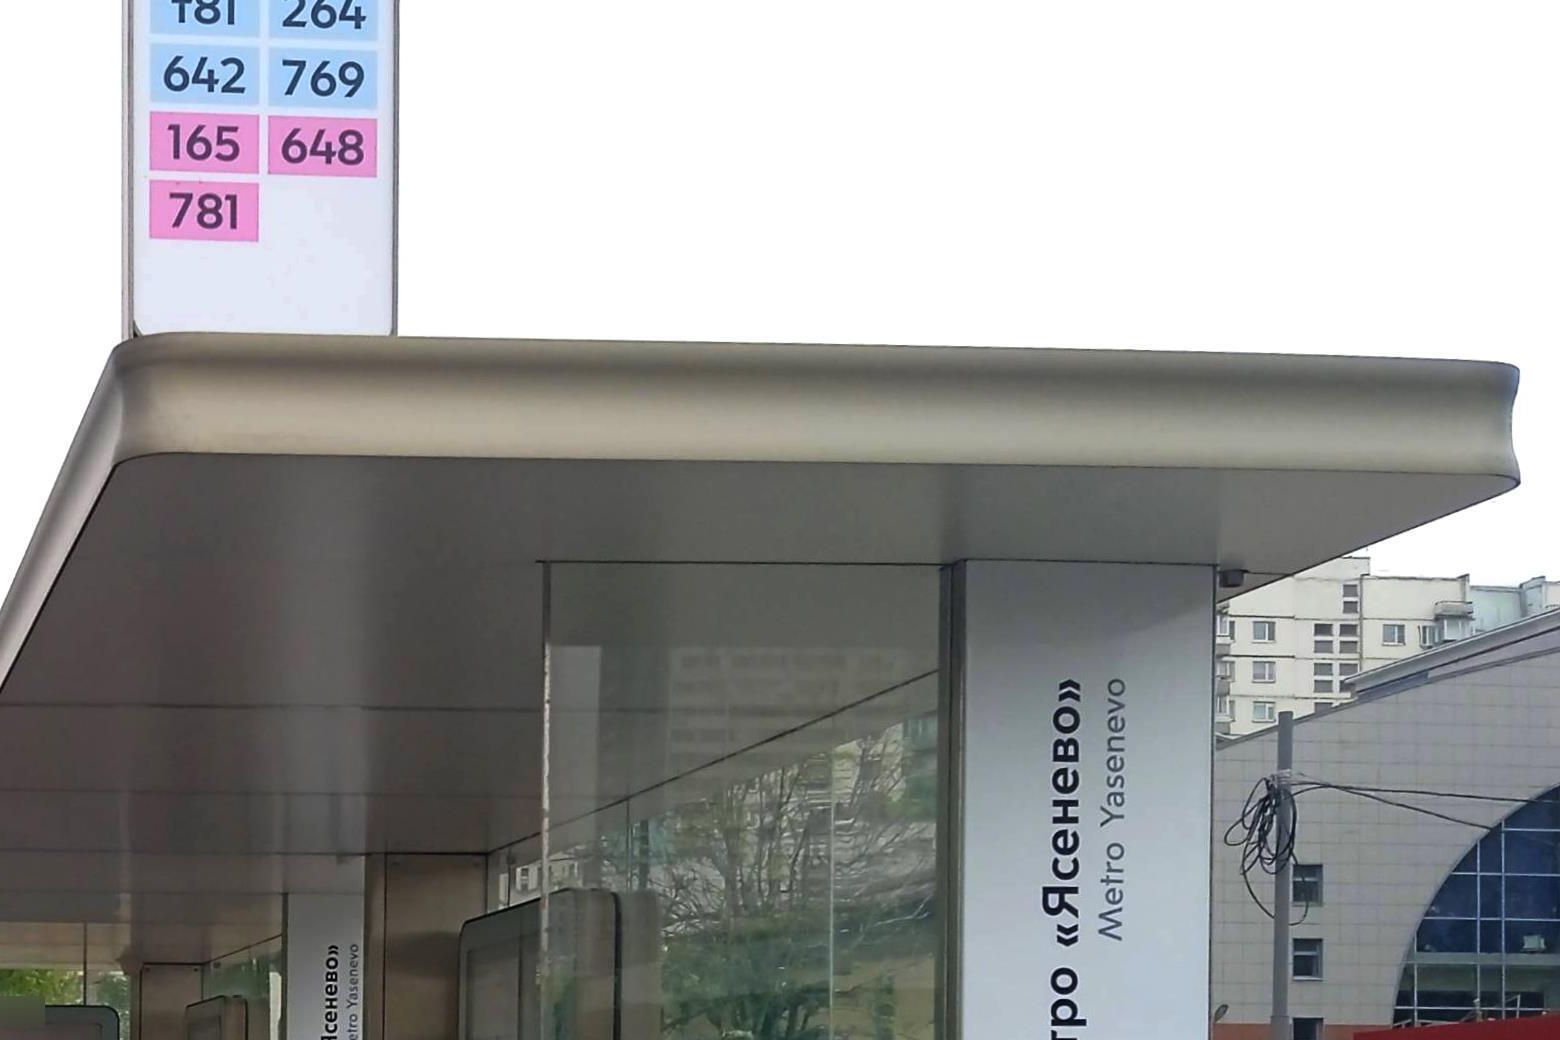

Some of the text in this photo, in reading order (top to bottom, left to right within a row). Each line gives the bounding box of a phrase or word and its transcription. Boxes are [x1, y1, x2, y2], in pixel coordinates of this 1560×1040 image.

[282, 0, 366, 29] 264
[163, 55, 246, 93] 642
[282, 59, 365, 97] 769
[167, 124, 240, 162] 165
[281, 128, 364, 166] 648
[169, 192, 238, 229] 781
[1042, 678, 1082, 948] «Ясенево»
[1098, 678, 1126, 941] Metro Yasenevo
[346, 943, 359, 1009] Yasenevo
